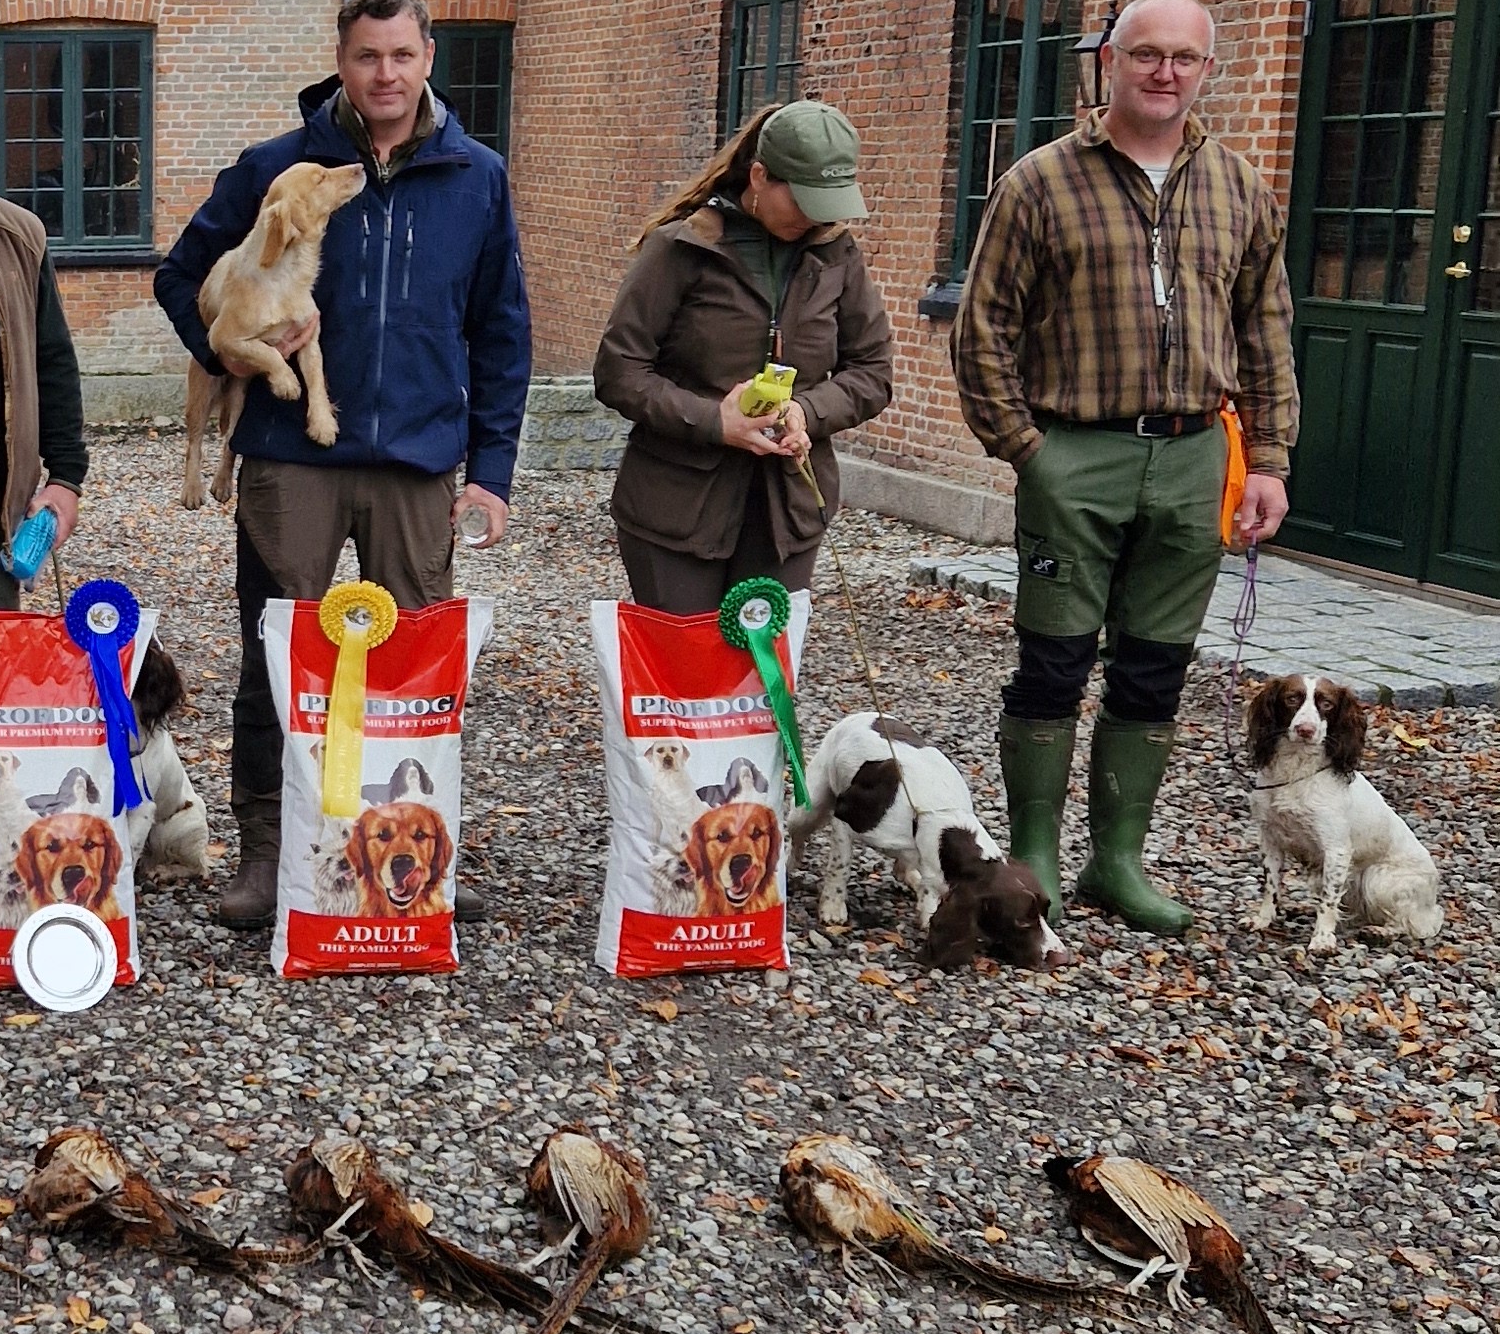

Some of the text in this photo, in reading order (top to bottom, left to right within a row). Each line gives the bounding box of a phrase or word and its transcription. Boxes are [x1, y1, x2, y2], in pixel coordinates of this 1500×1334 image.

[306, 695, 452, 715] PFDOG
[307, 715, 452, 728] SUP MIUM PET FOOD
[640, 718, 677, 727] SUPER
[724, 718, 745, 728] PET
[9, 727, 64, 737] PREMIUM
[66, 728, 87, 737] PET
[333, 925, 421, 942] ADULT
[670, 921, 756, 941] ADULT
[317, 943, 347, 953] THE
[350, 943, 401, 953] FAMILY
[654, 938, 766, 952] THE FAMILY DOG
